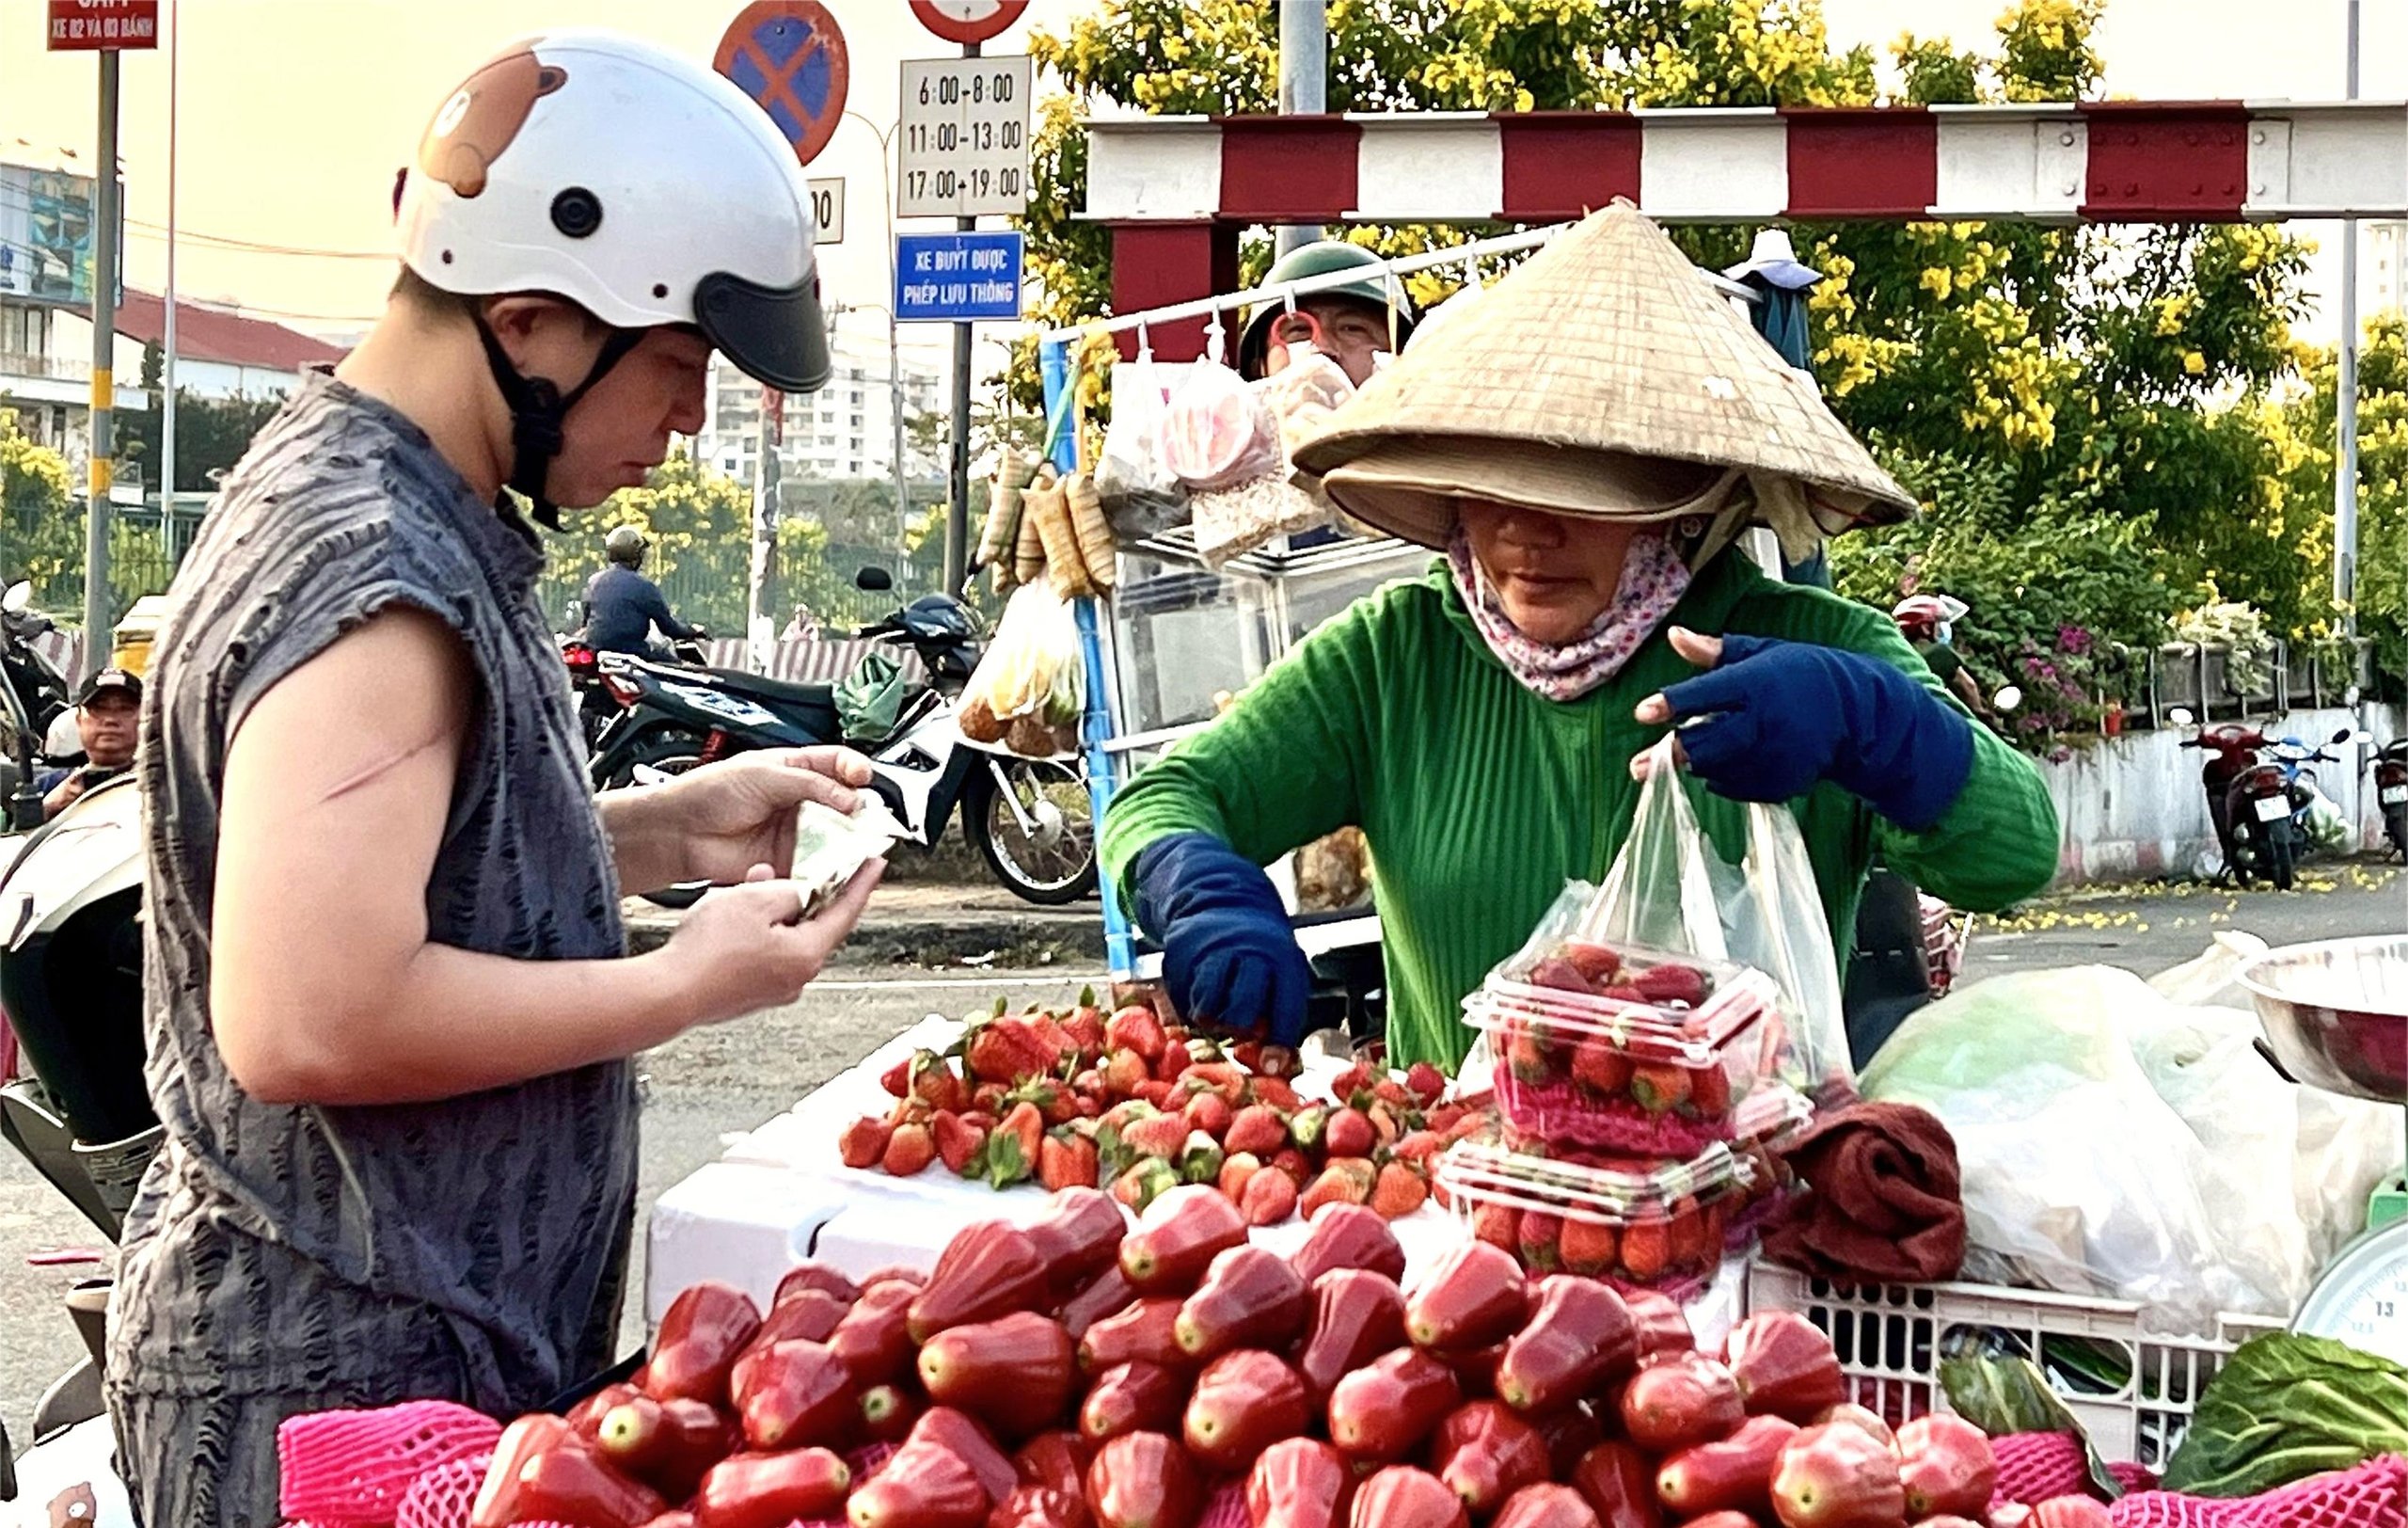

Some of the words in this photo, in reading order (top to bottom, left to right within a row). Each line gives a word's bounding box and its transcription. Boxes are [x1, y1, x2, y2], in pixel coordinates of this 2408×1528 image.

[52, 18, 67, 38] XE
[86, 12, 102, 38] VÀ
[914, 251, 932, 271] XE
[903, 279, 938, 305] PHÉP
[2375, 1301, 2394, 1317] 13
